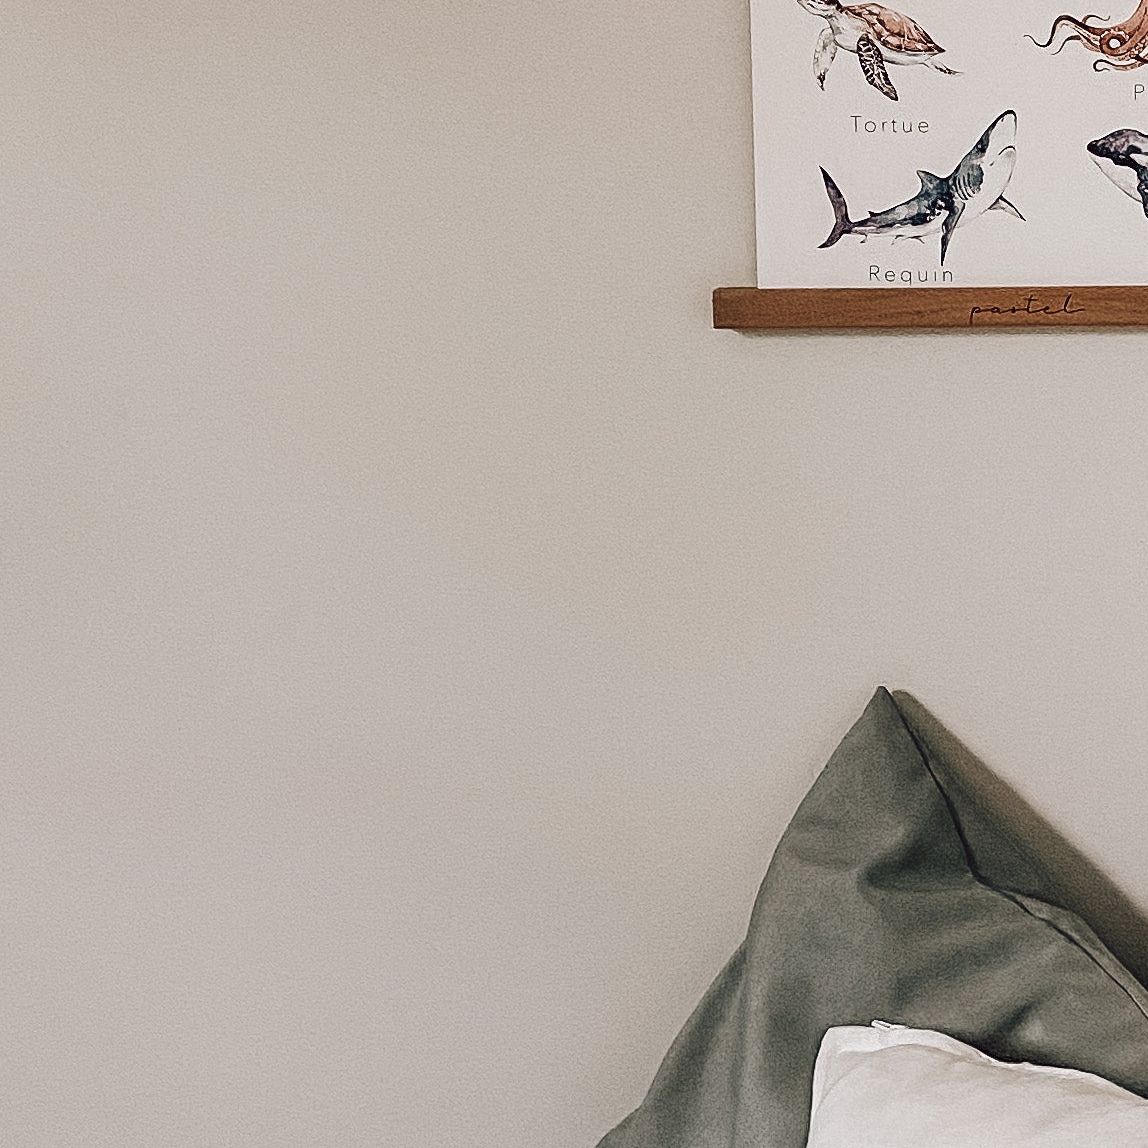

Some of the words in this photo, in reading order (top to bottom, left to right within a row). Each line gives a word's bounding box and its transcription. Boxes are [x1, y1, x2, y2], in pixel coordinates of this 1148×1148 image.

[849, 115, 929, 134] Tortue
[868, 264, 953, 286] Requin
[969, 293, 1087, 325] pastel
